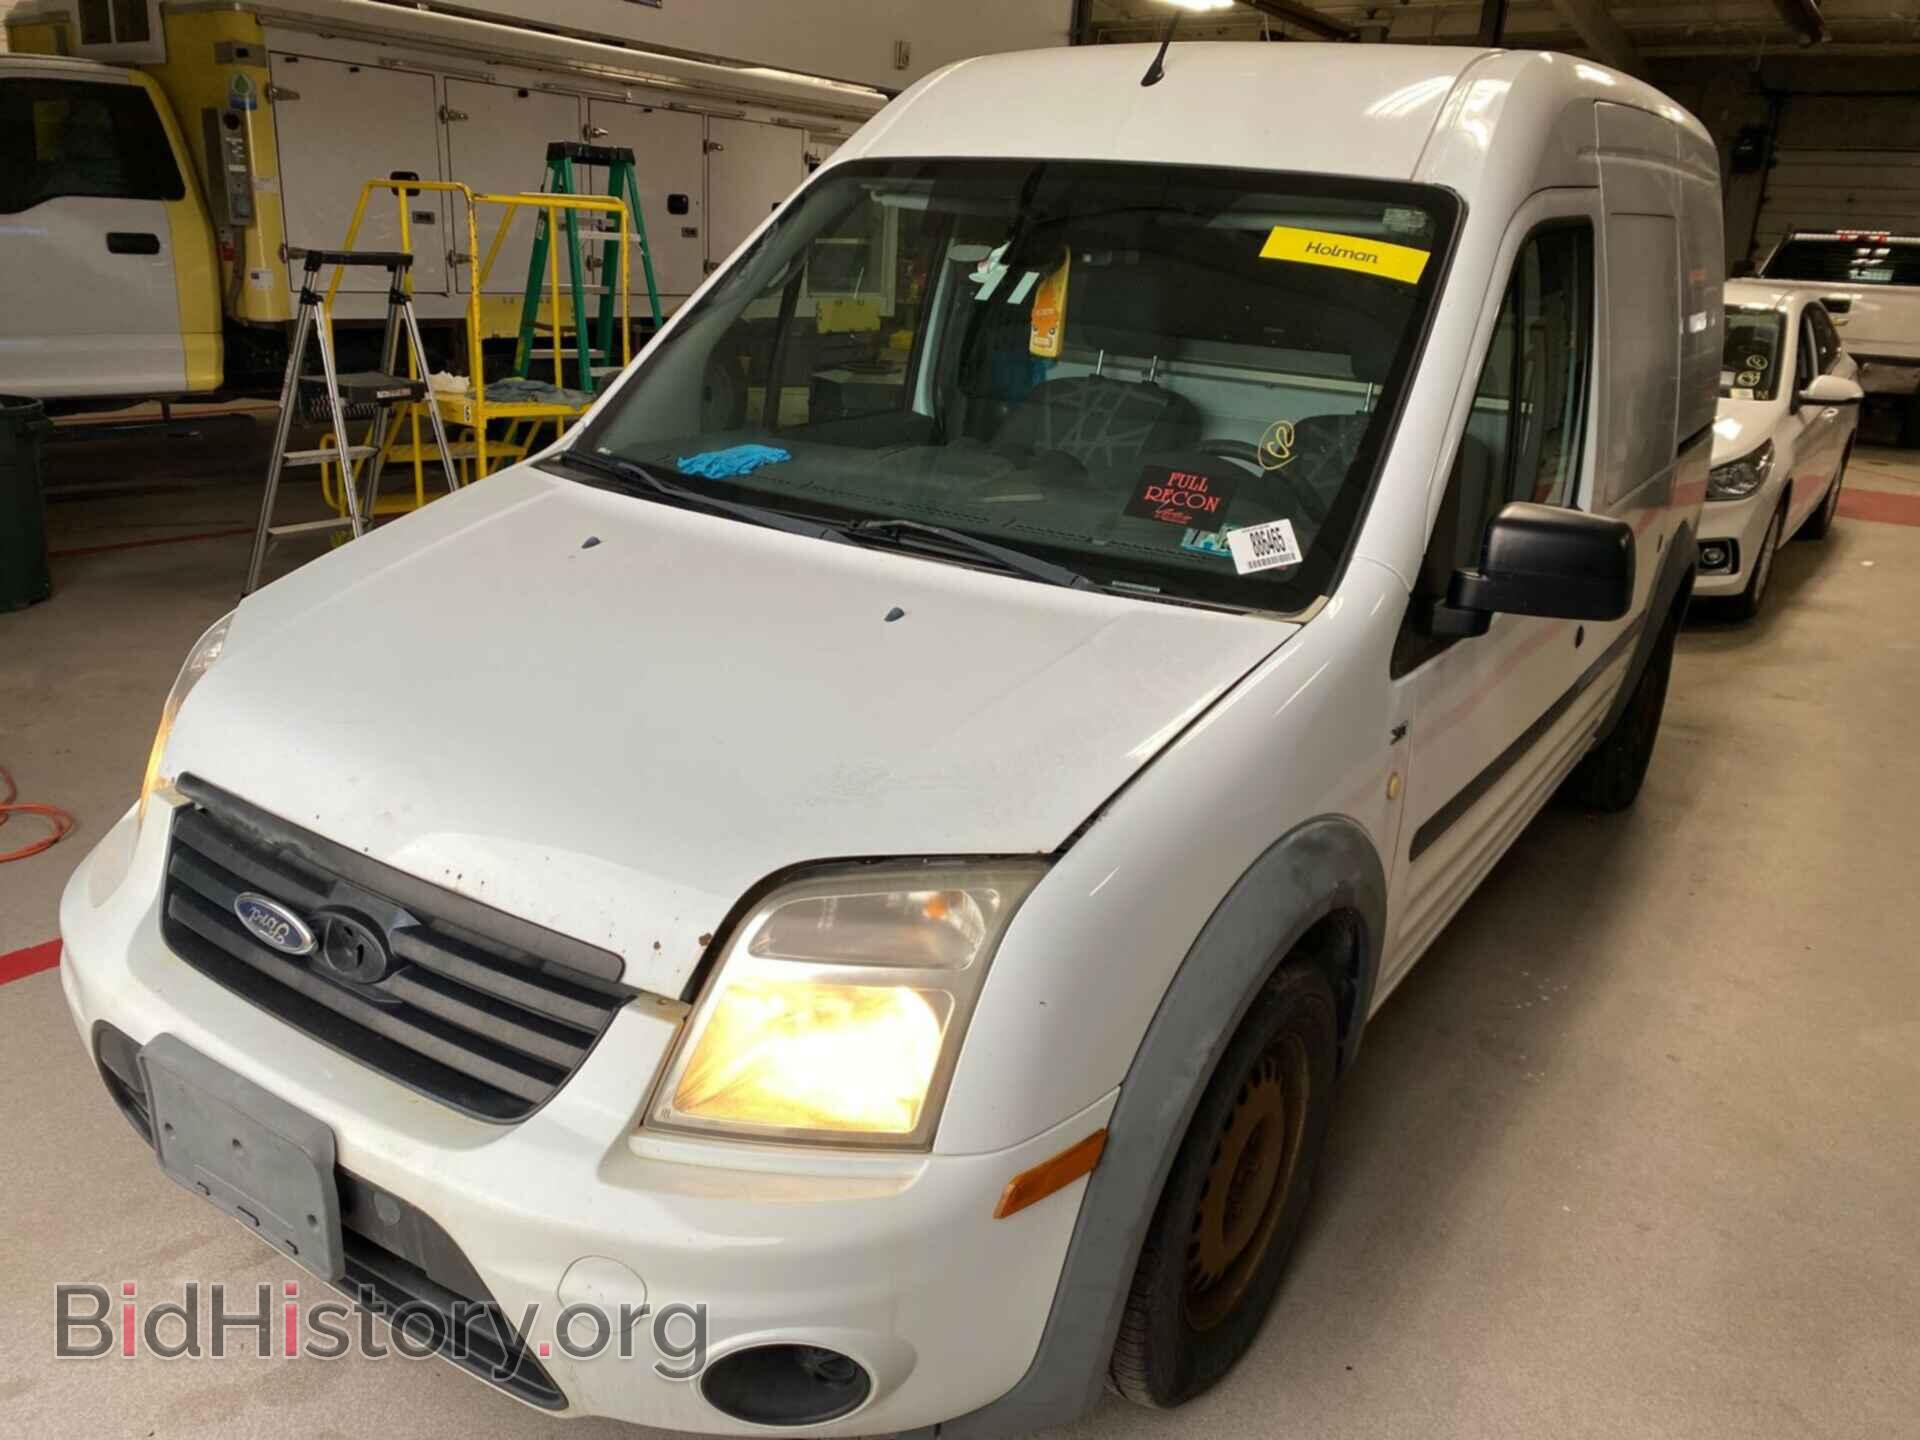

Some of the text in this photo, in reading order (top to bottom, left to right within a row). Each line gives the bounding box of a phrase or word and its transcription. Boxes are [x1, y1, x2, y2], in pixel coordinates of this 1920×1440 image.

[1305, 240, 1379, 264] Holman
[1168, 471, 1209, 493] FULL
[1144, 485, 1220, 512] RECON
[248, 905, 290, 945] Ford
